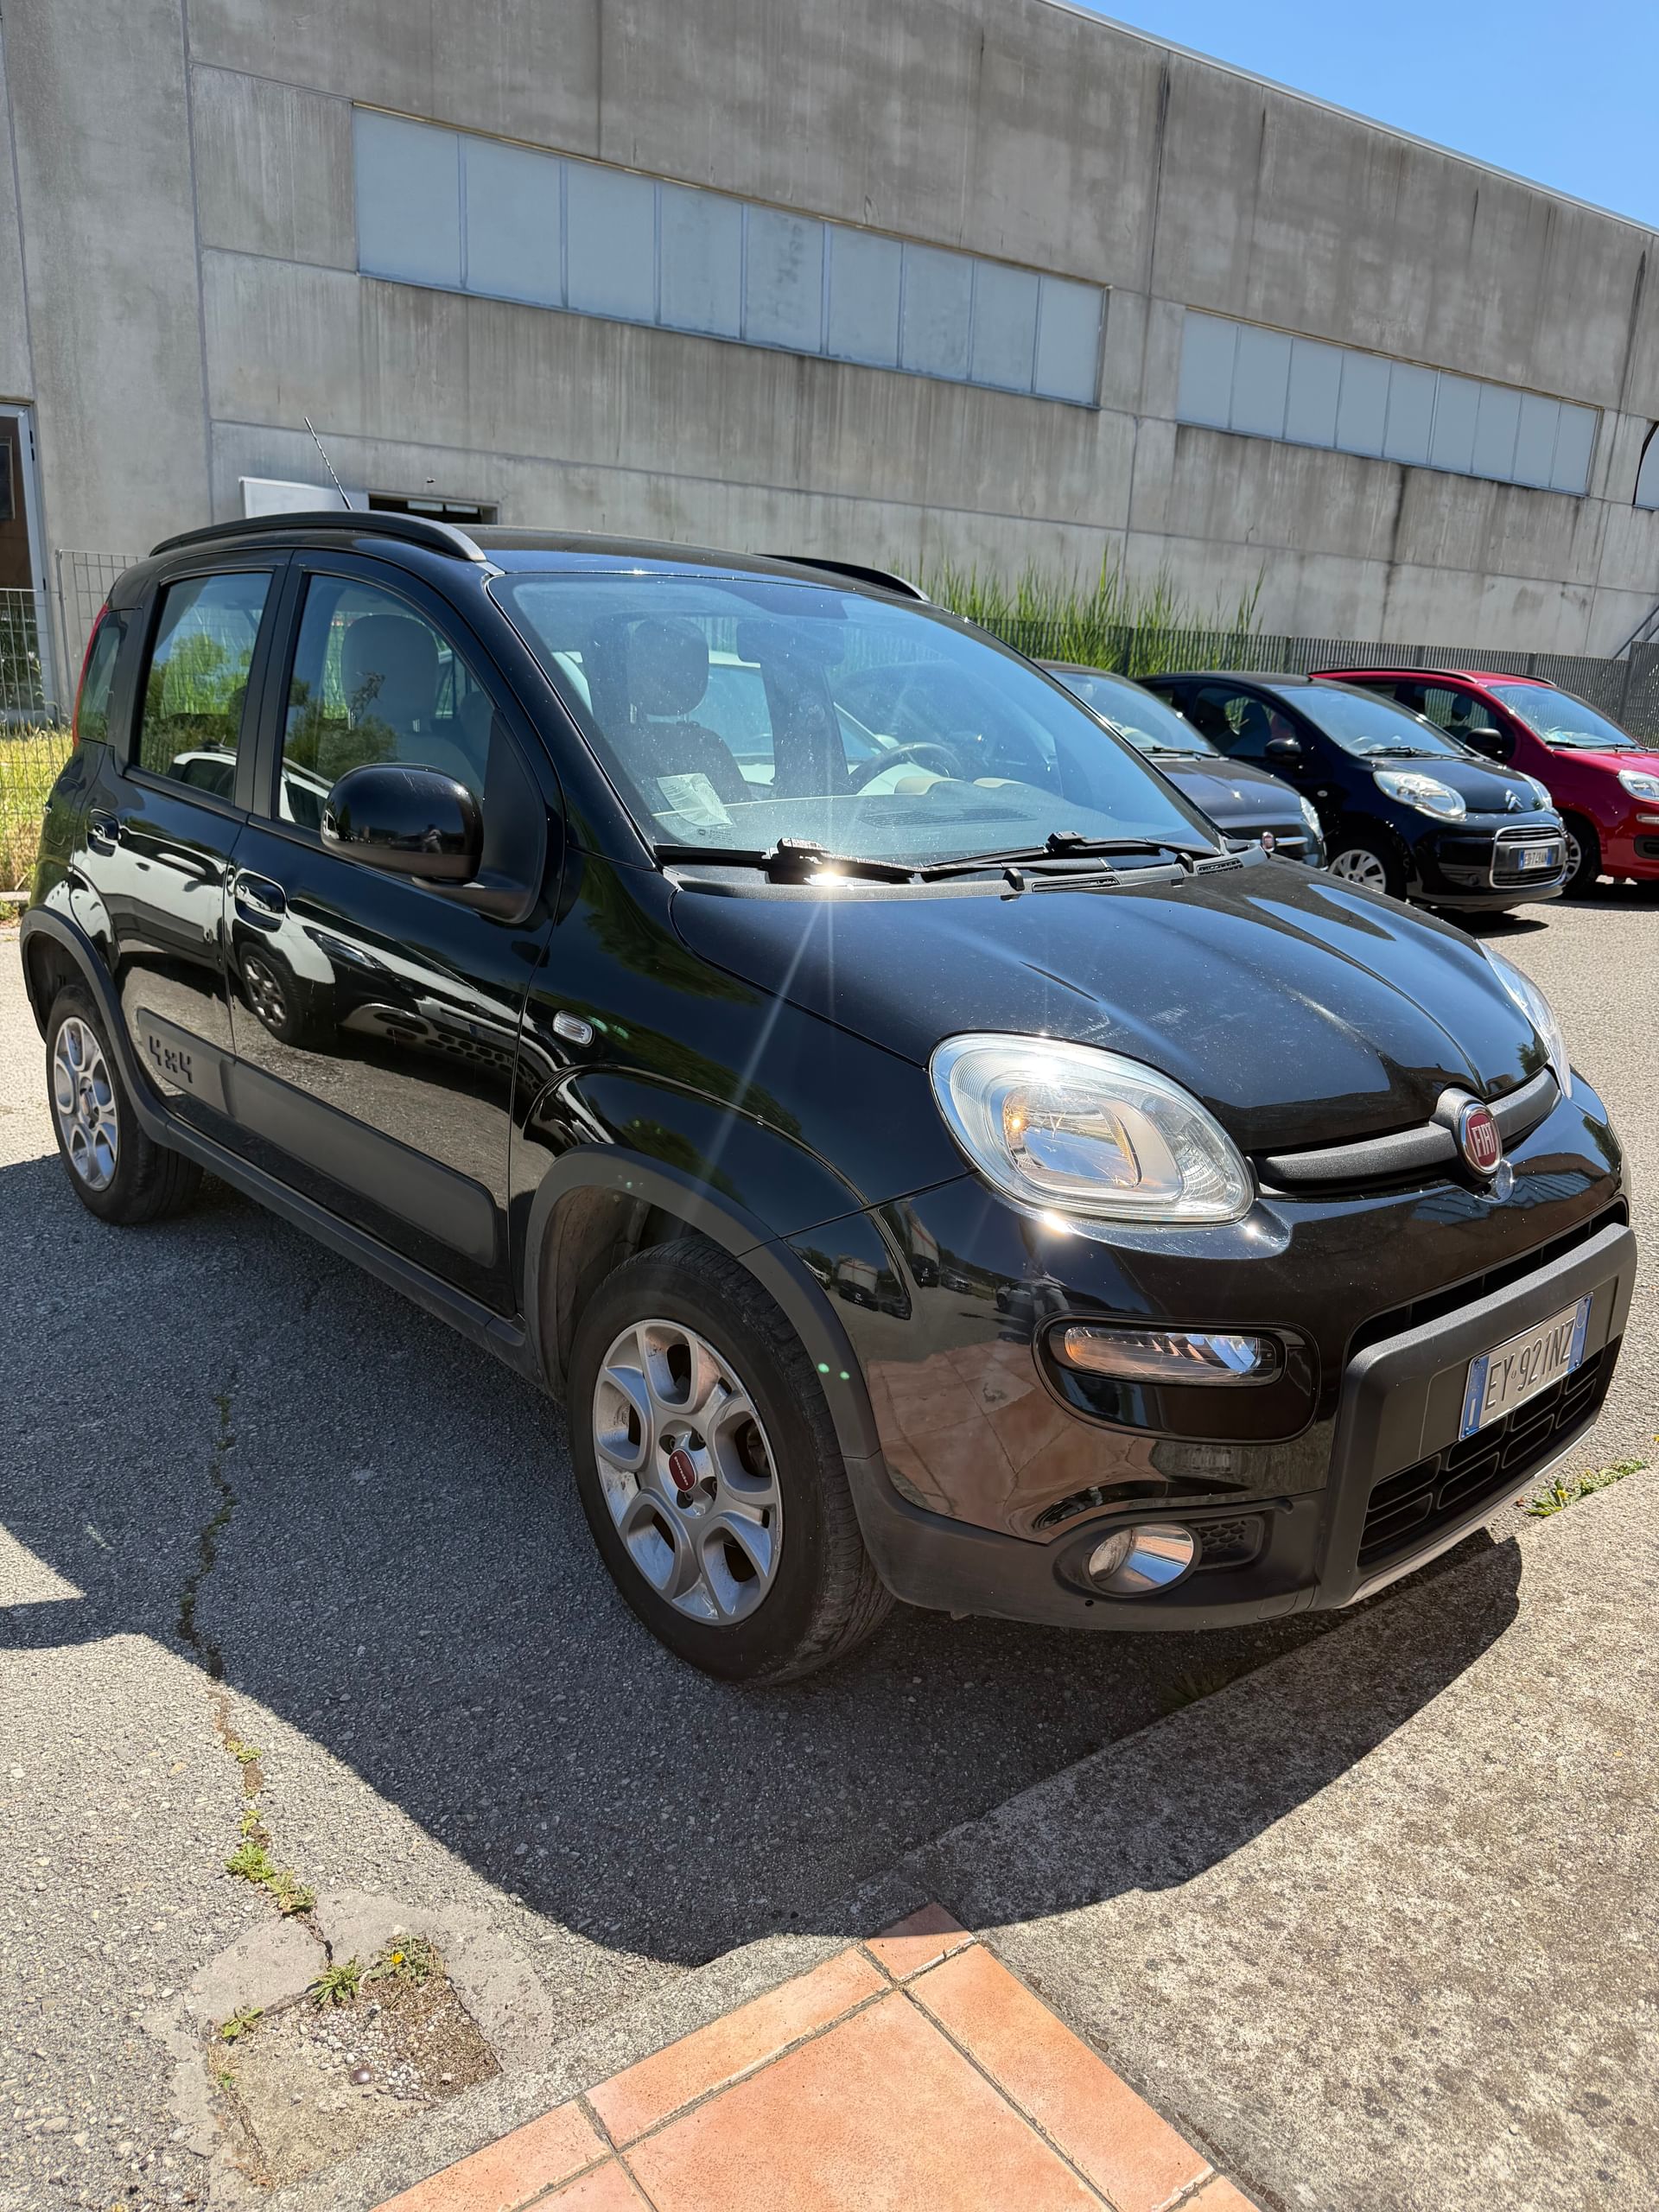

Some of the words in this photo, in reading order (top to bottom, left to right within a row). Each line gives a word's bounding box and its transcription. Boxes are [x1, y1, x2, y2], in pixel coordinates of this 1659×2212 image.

[149, 1035, 194, 1084] 4x4
[1471, 1122, 1496, 1157] FIAT
[1484, 1353, 1515, 1410] EY
[1516, 1317, 1575, 1392] 921NZ
